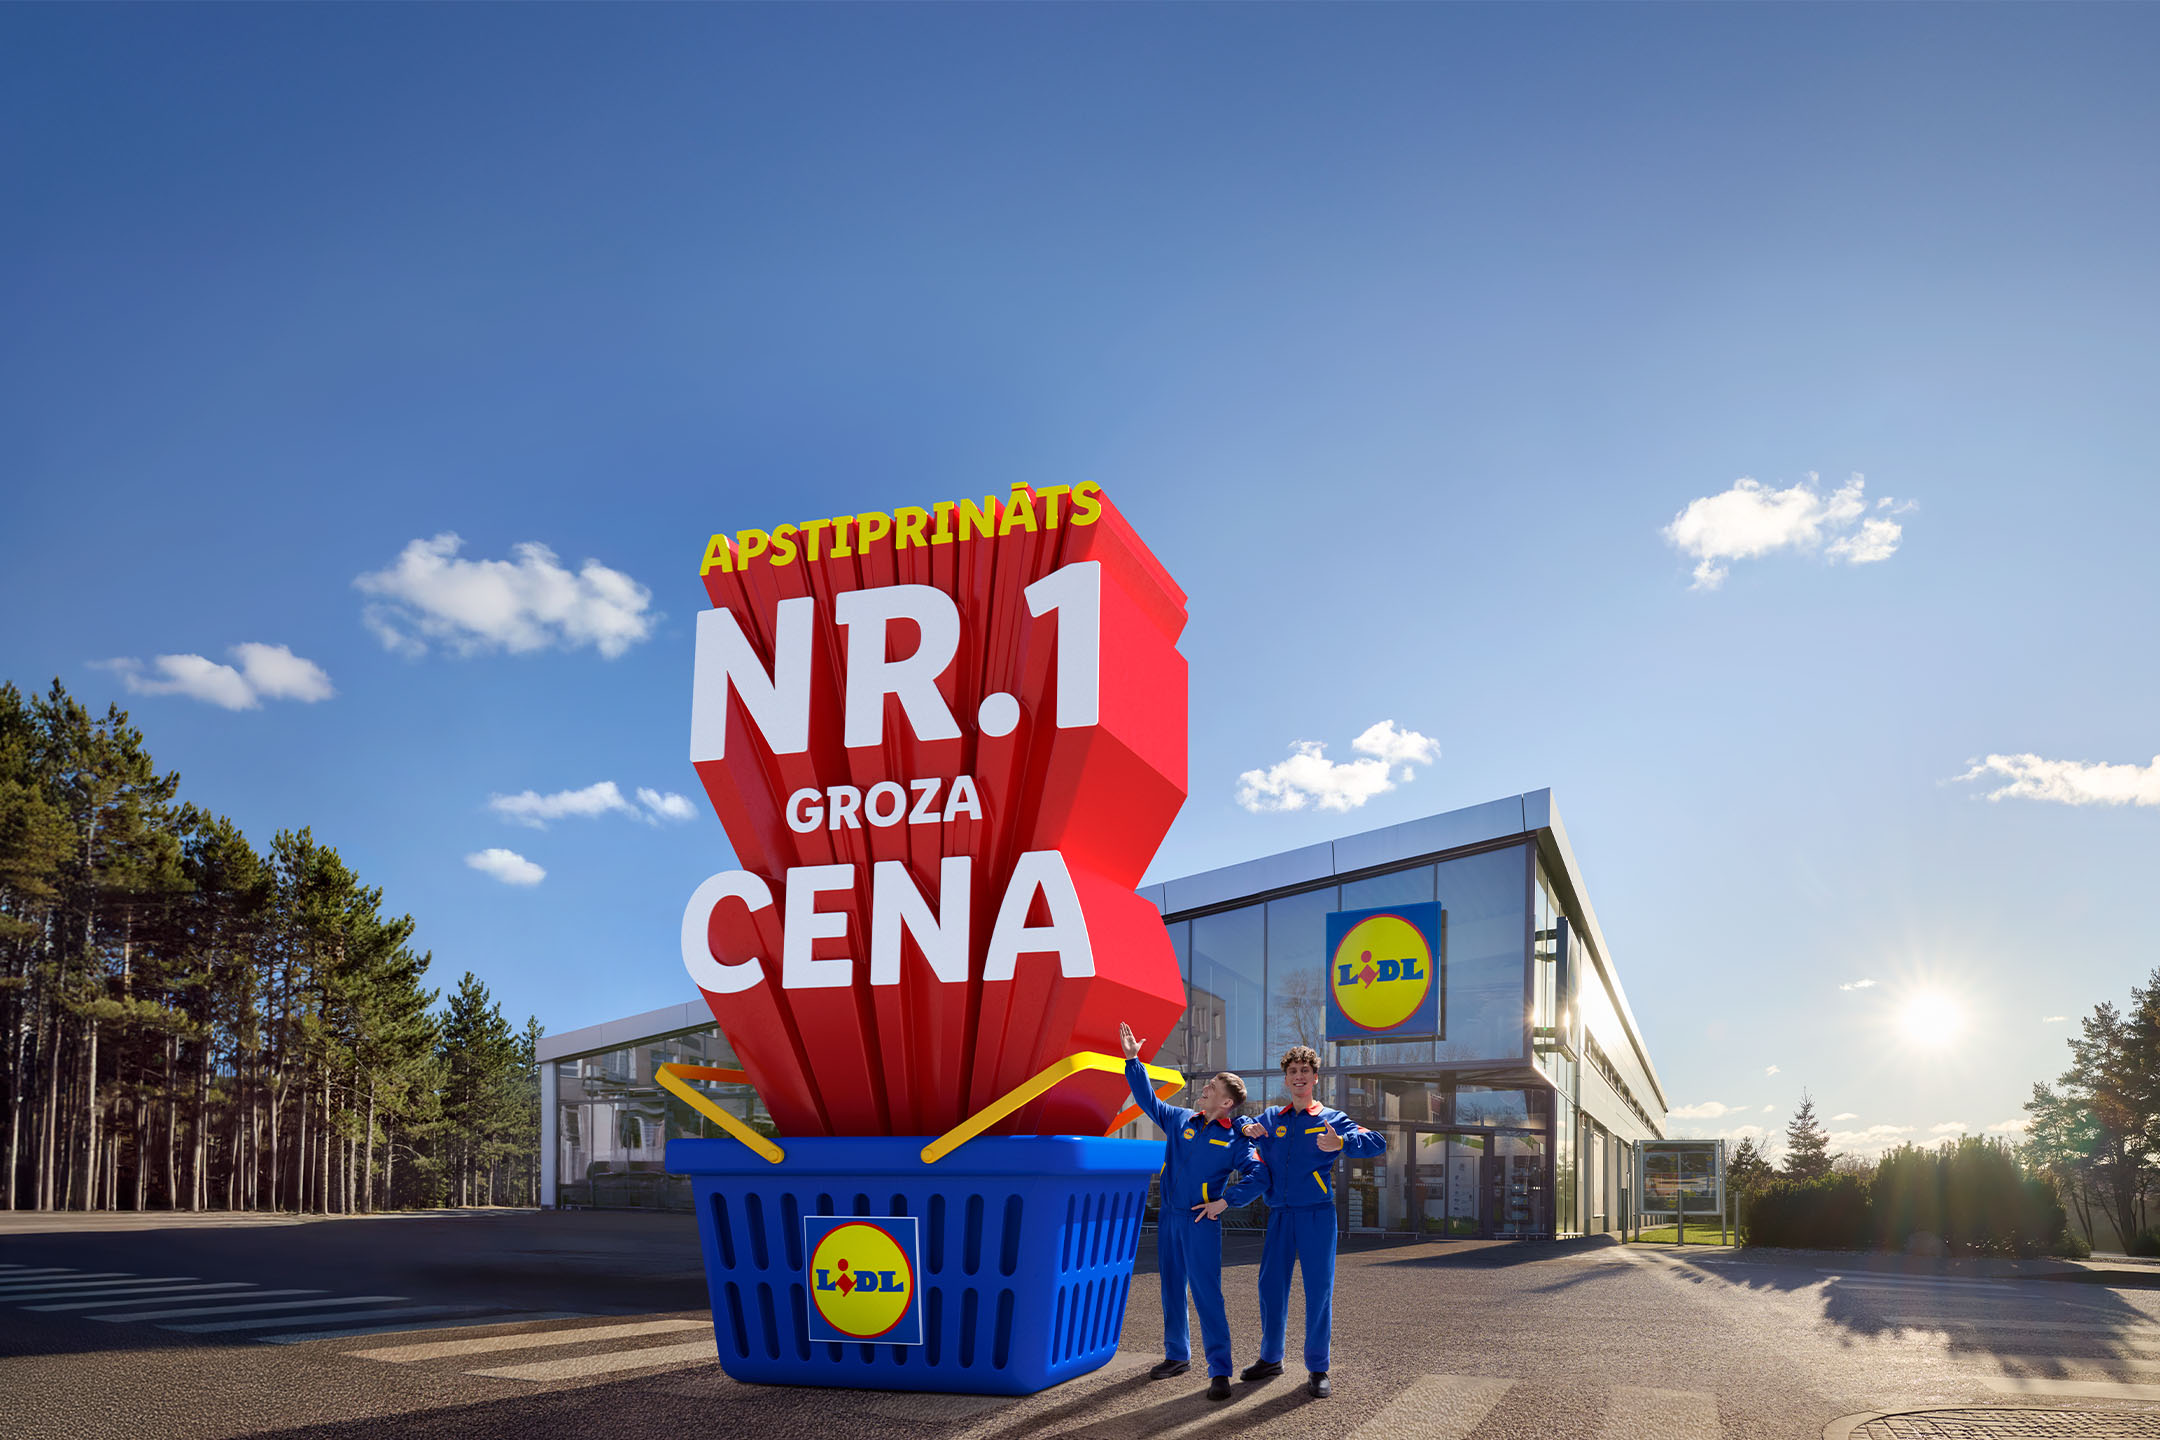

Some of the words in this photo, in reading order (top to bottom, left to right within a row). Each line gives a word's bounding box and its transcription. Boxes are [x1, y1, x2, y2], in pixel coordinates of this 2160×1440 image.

[699, 480, 1101, 576] APSTIPRINĀTS
[690, 560, 1101, 763] NR.1
[786, 775, 983, 833] GROZA
[681, 850, 1096, 995] CENA
